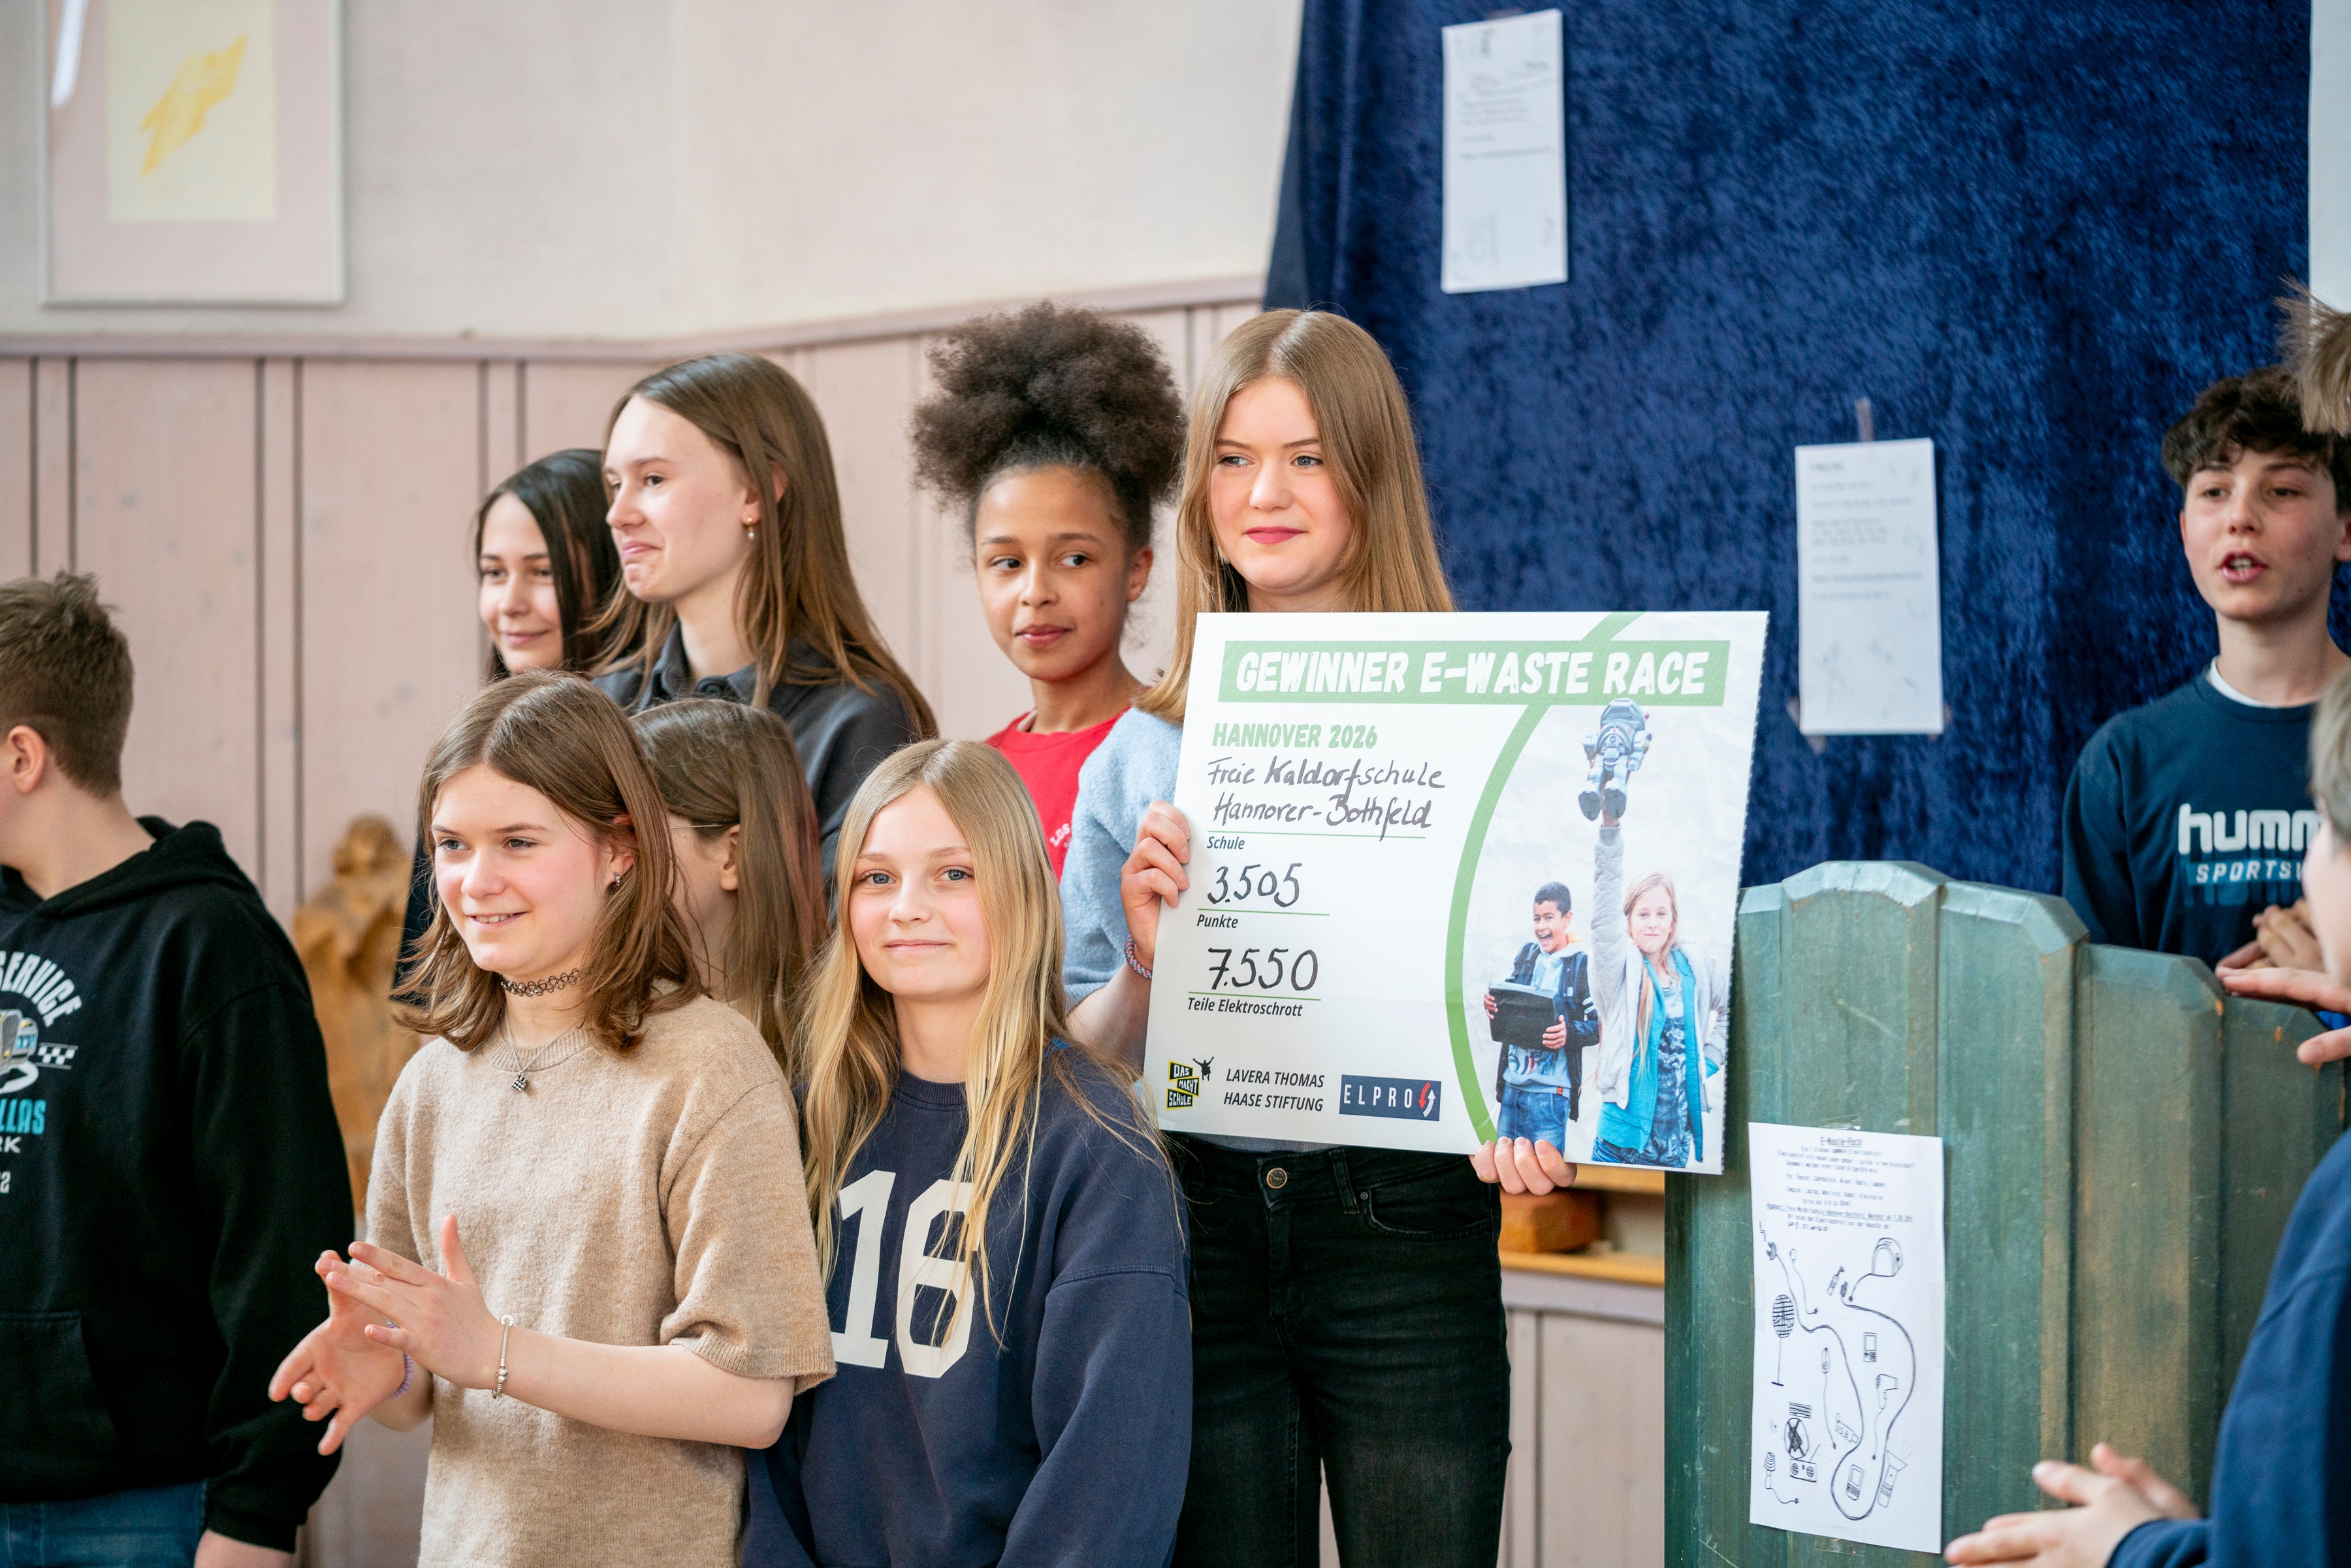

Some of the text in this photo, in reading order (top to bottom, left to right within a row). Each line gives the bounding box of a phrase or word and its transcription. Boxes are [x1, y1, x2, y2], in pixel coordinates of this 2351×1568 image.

[1236, 651, 1710, 695] GEWINNER E-WASTE RACE
[1213, 722, 1378, 749] HANNOVER 2026
[1208, 756, 1255, 786] Freie
[1207, 836, 1245, 850] Schule
[2196, 859, 2303, 884] SPORTS
[1207, 863, 1302, 908] 3.505
[1196, 914, 1238, 929] Punkte
[1208, 948, 1319, 991] 7.550
[1188, 997, 1303, 1017] Teile Elektroschrott
[1174, 1064, 1190, 1078] DAS
[1226, 1068, 1324, 1088] LAVERA THOMAS
[1179, 1079, 1198, 1094] MACHT
[1343, 1083, 1413, 1108] ELPRO
[1168, 1091, 1192, 1107] SCHULE
[1223, 1092, 1323, 1112] HAASE STIFTUNG
[831, 1170, 979, 1378] 16
